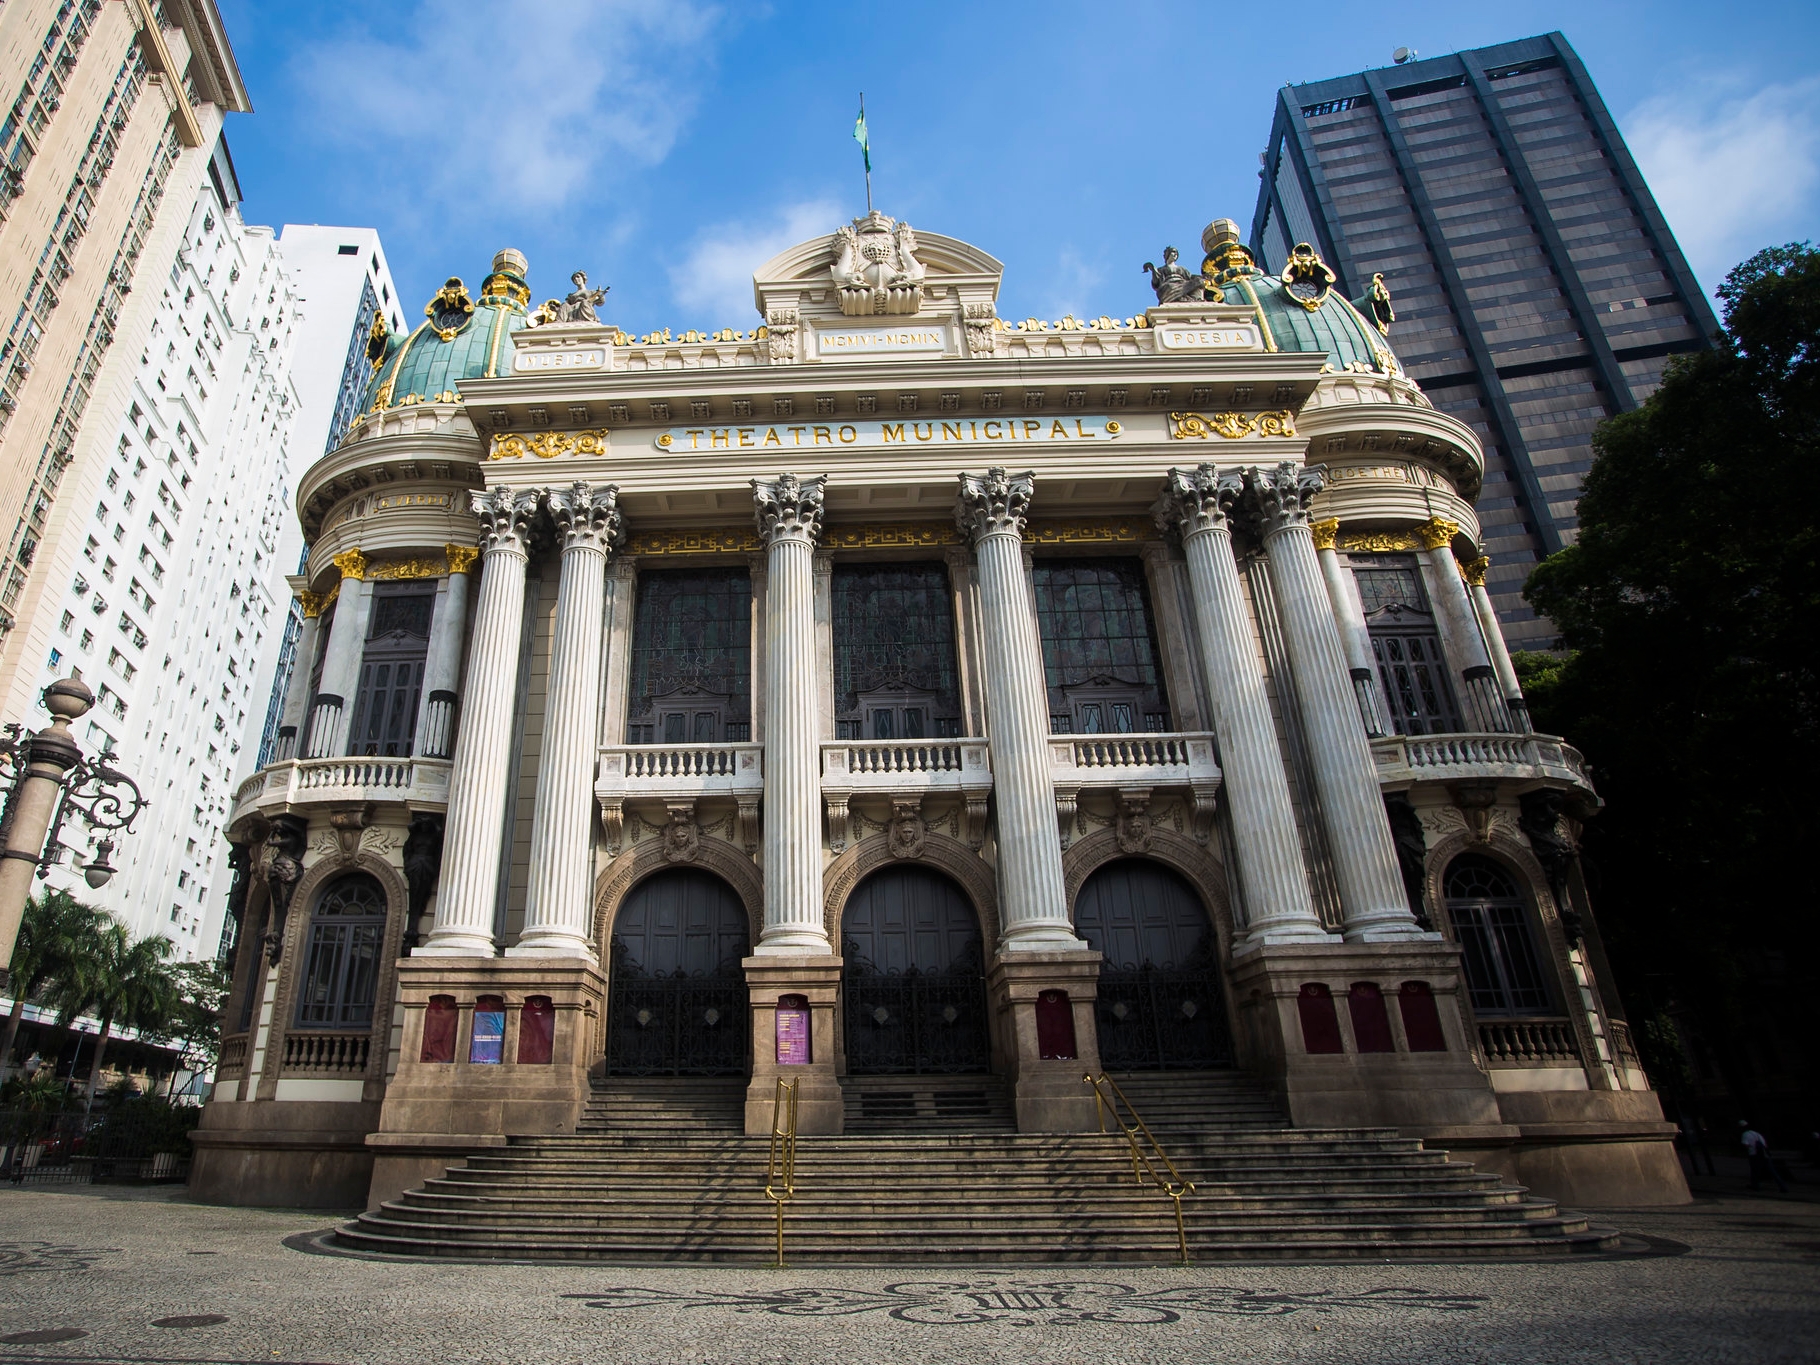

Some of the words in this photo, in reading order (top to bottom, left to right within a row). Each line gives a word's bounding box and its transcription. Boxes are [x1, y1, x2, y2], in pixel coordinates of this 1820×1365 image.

[1173, 332, 1245, 344] POESIA
[525, 353, 597, 368] MUSICA
[685, 424, 857, 449] THEATRO
[881, 418, 1095, 443] MUNICIPAL
[1334, 467, 1403, 478] GOETHE
[396, 495, 443, 505] VERDI
